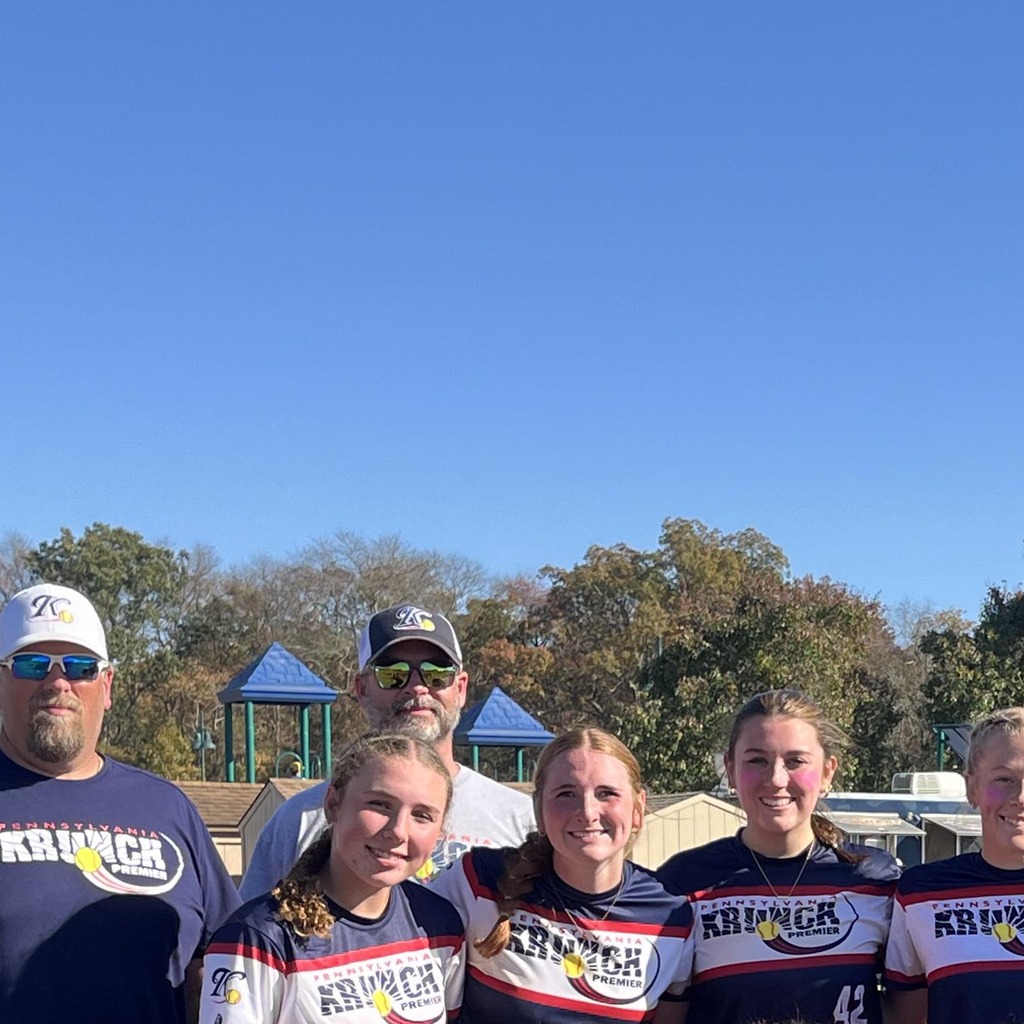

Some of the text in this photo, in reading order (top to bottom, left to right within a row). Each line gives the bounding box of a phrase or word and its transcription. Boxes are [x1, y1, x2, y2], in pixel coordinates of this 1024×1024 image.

[0, 822, 159, 839] PENNSYLVANIA
[0, 828, 167, 870] KRUNCH
[111, 864, 168, 880] PREMIER
[701, 896, 836, 911] PENNSYLVAN
[701, 901, 840, 940] KRUNCH
[788, 926, 840, 939] PREMIER
[506, 922, 643, 977] KRUNCH
[313, 952, 431, 982] PENNSYLVANIA
[317, 963, 441, 1016] KRUNCH
[592, 975, 643, 989] PREMIER
